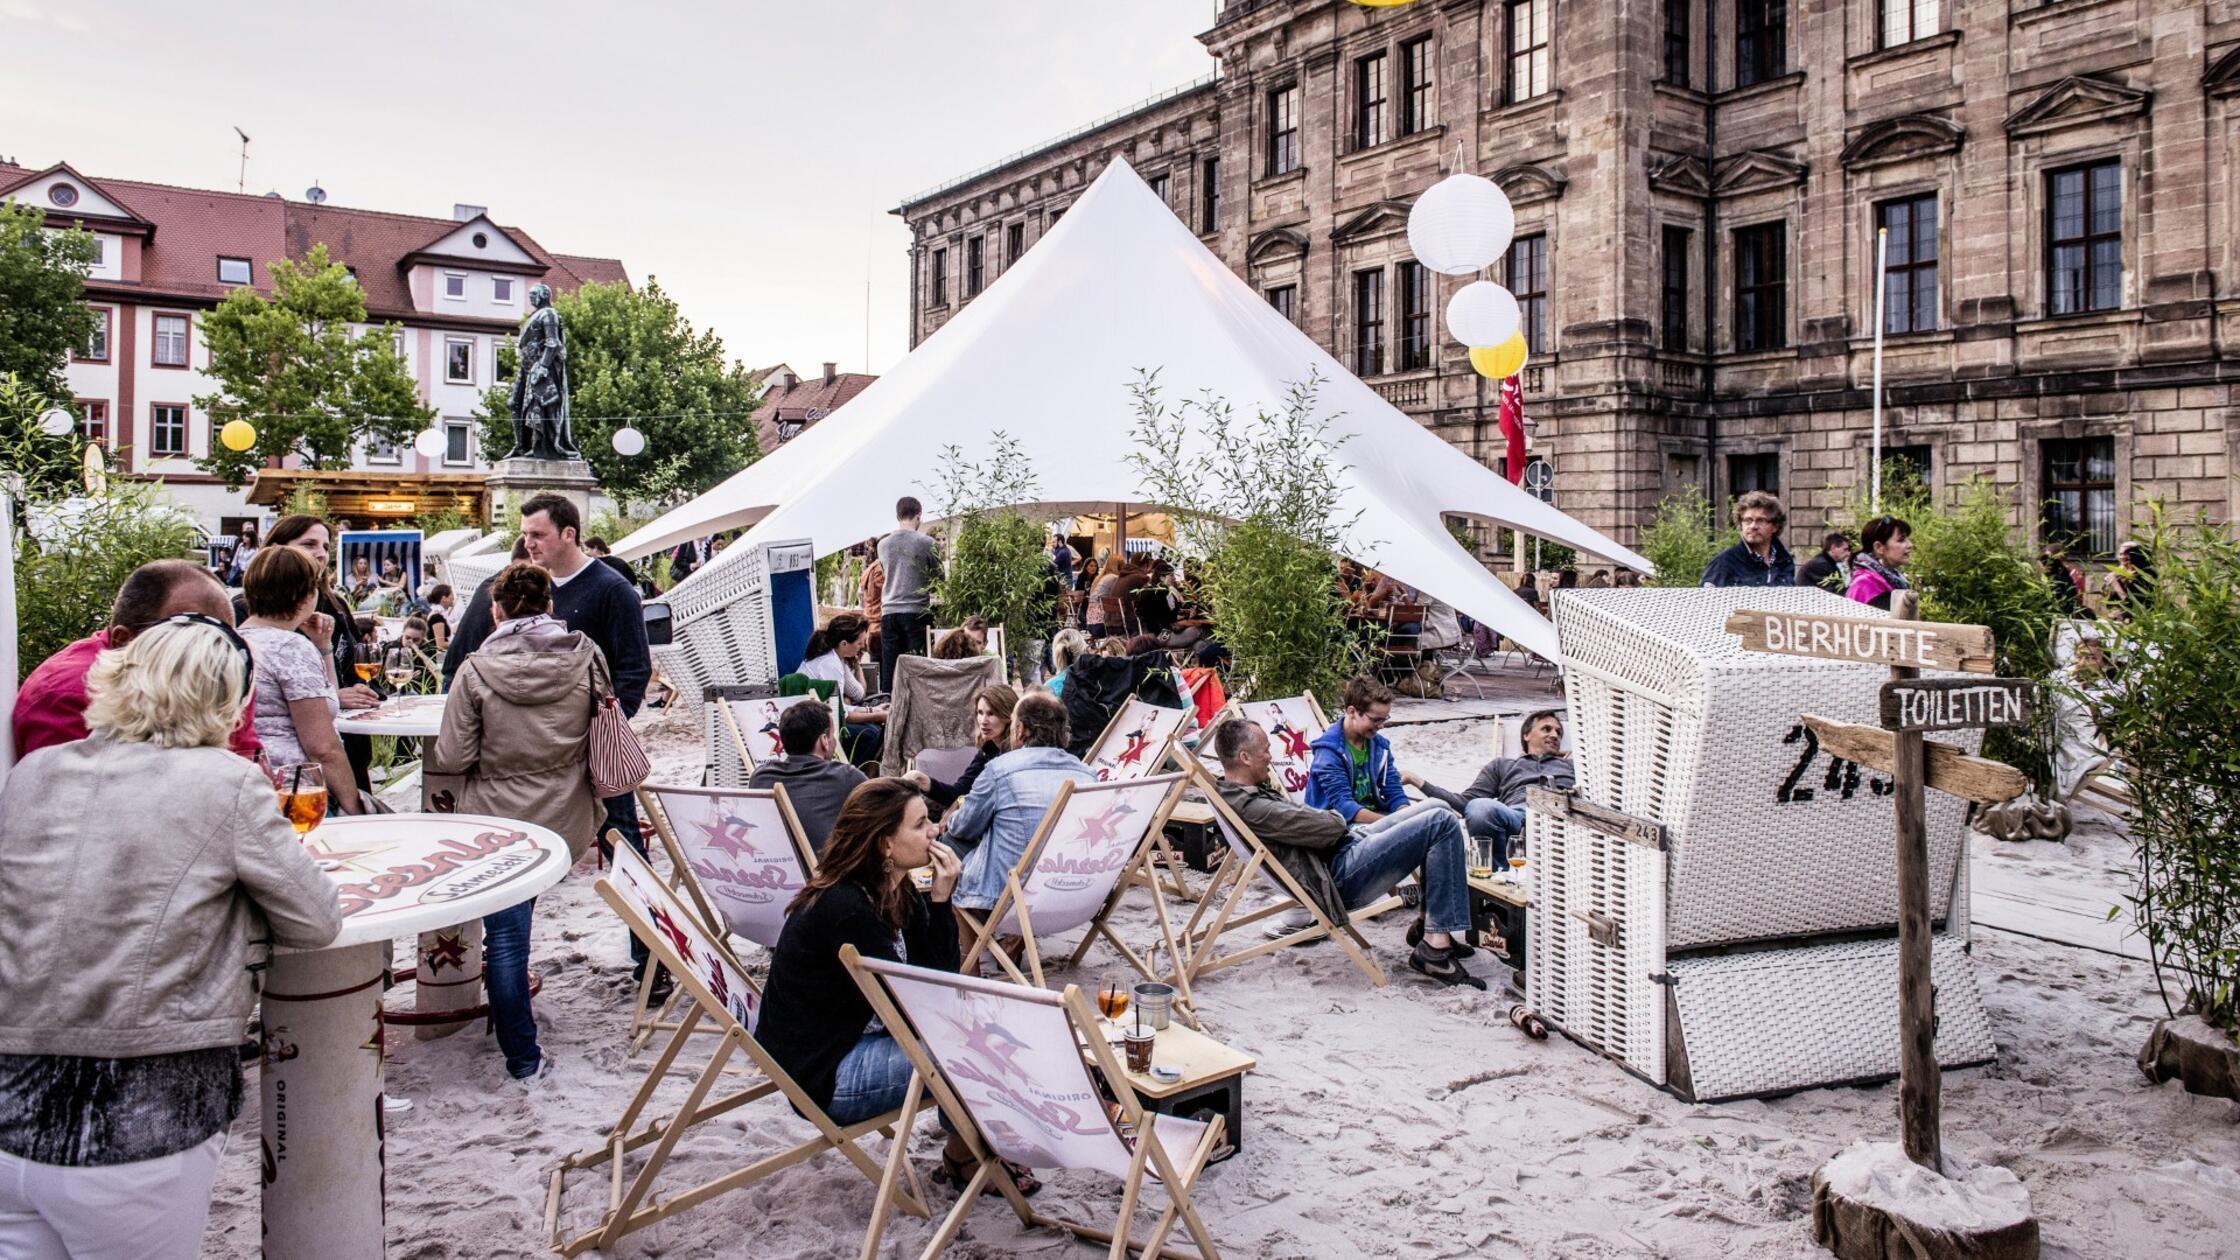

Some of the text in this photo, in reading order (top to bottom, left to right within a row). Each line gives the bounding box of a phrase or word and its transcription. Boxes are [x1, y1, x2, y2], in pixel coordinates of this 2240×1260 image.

[1765, 615, 1938, 666] BIERHÜTTE
[1893, 687, 2022, 727] TOILETTEN
[1636, 823, 1657, 842] 243
[276, 1080, 287, 1163] ORIGINAL
